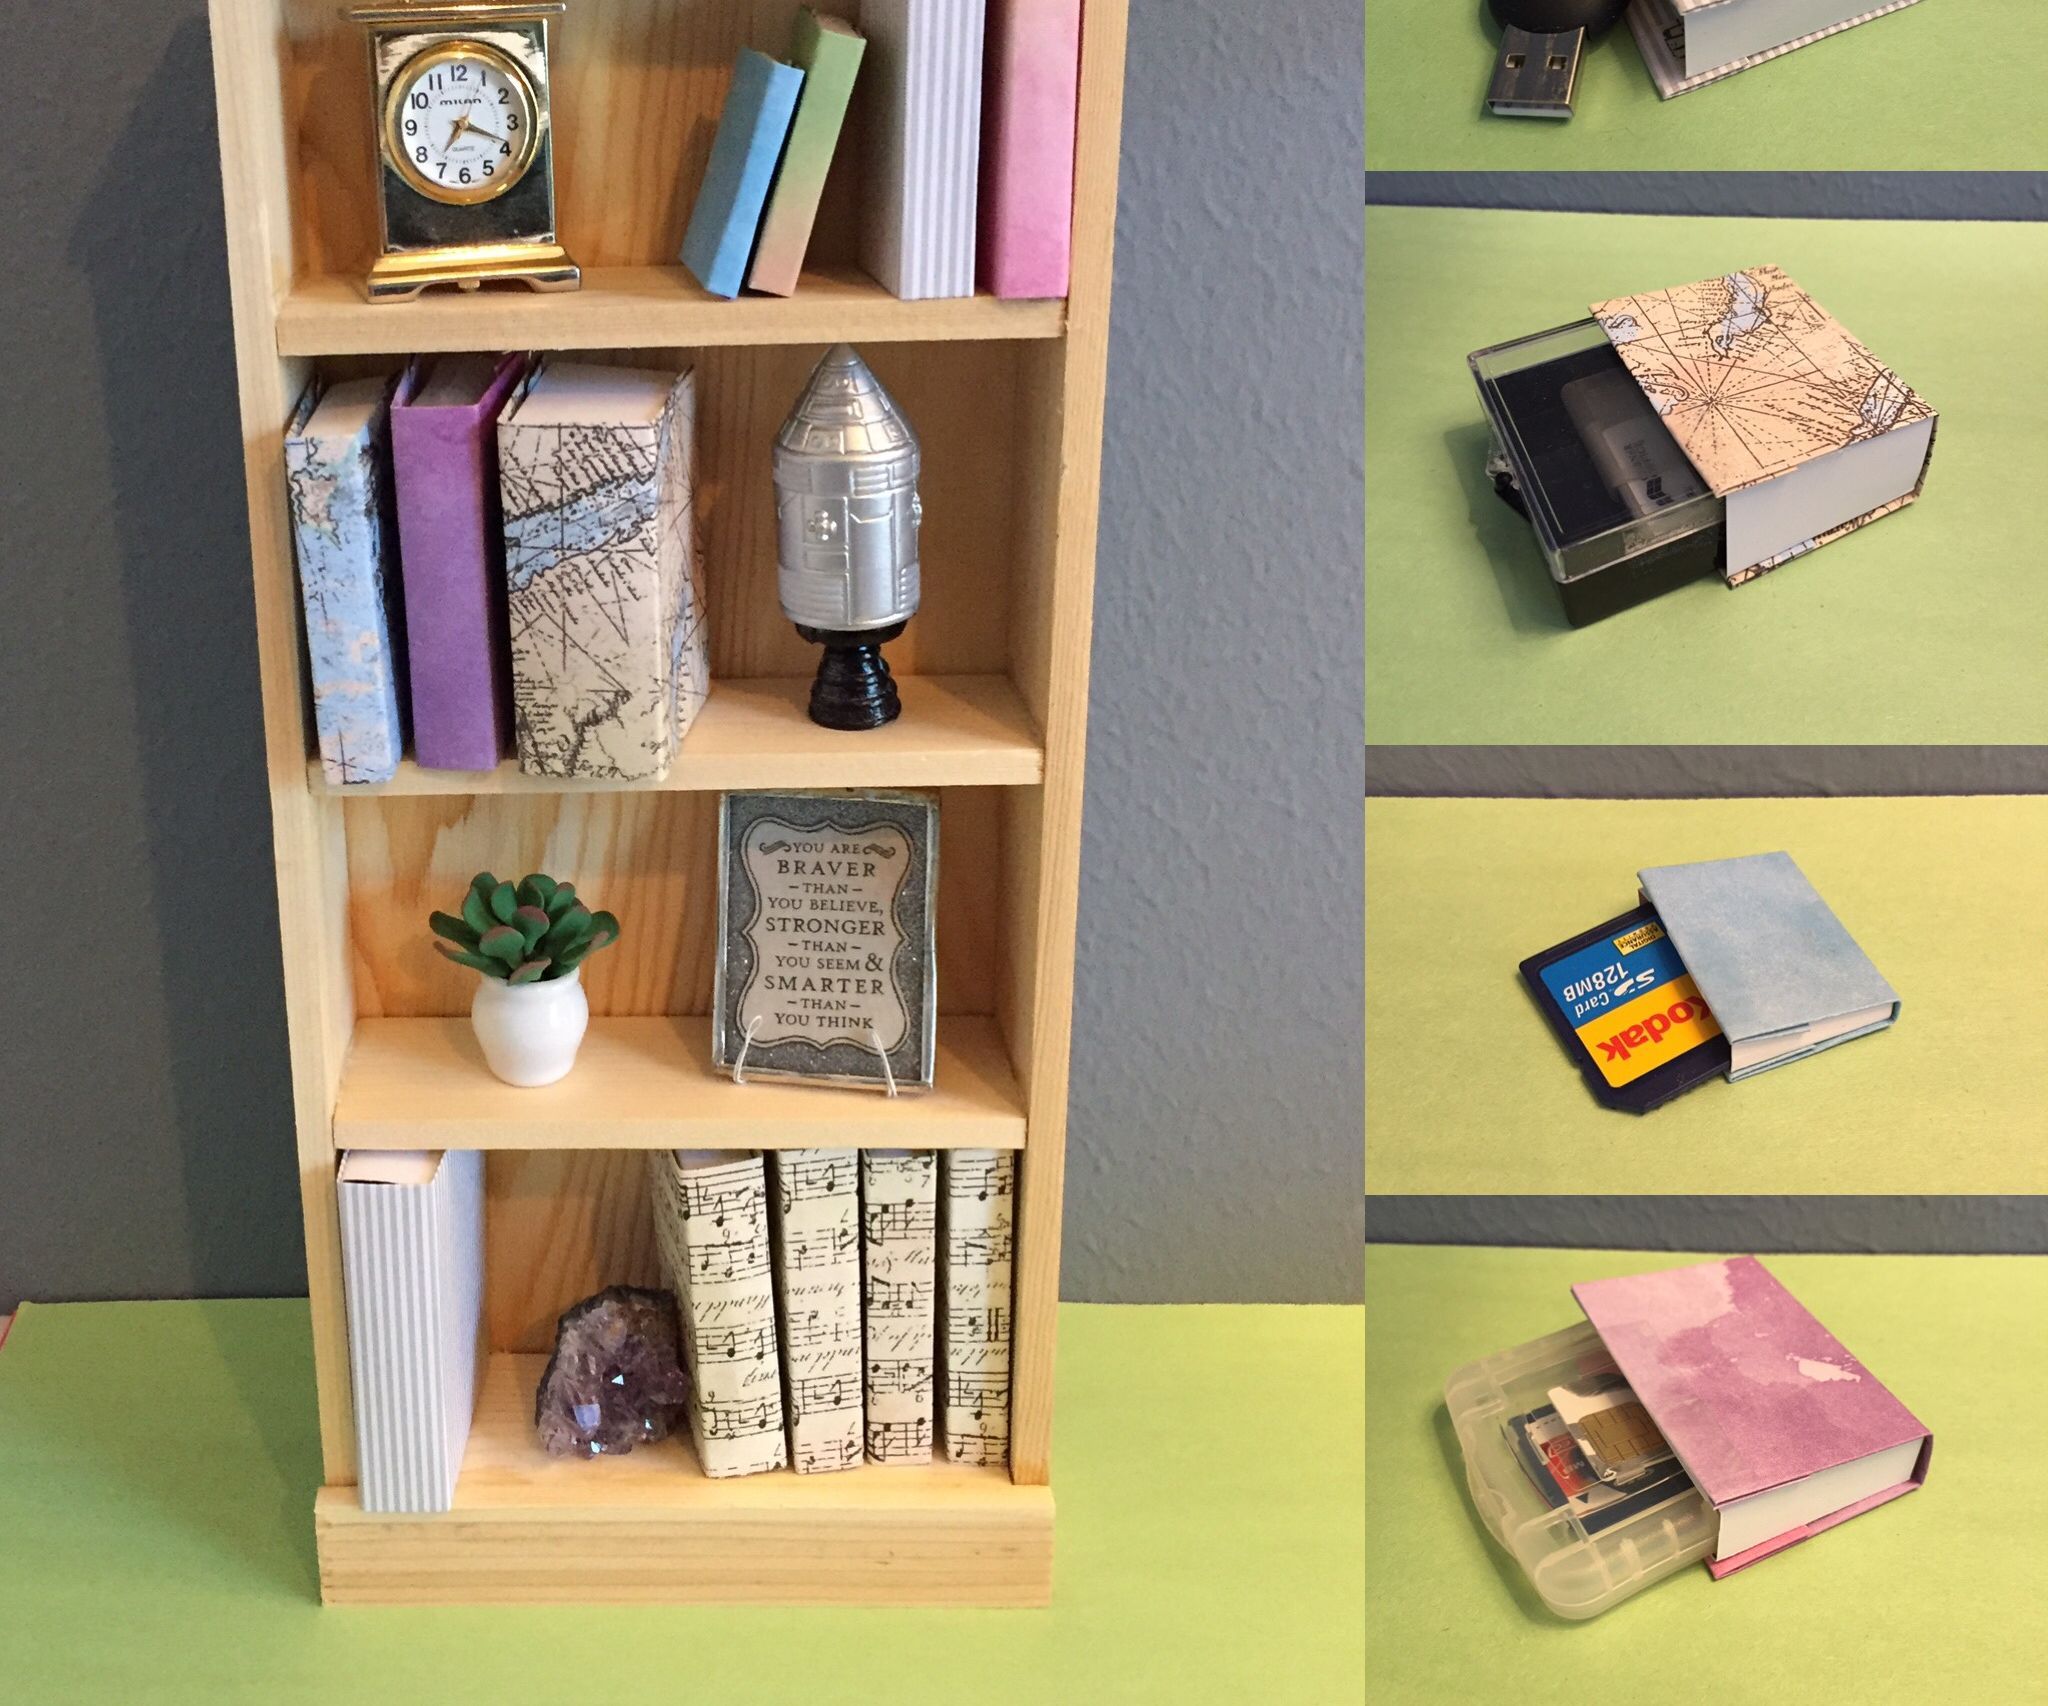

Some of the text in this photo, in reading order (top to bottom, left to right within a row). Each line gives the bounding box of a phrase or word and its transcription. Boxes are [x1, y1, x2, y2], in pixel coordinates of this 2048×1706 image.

[428, 73, 442, 91] 11
[451, 64, 468, 82] 12
[481, 69, 487, 87] 1
[411, 92, 429, 110] 10
[497, 87, 510, 105] 2
[405, 119, 418, 136] 9
[506, 113, 519, 131] 3
[416, 146, 428, 163] 8
[500, 141, 512, 157] 4
[436, 162, 447, 179] 7
[459, 167, 472, 184] 6
[482, 160, 495, 177] 5
[792, 842, 860, 854] YOU ARE
[777, 859, 876, 877] BRAVER
[768, 896, 884, 916] YOU BELIEVE,
[765, 917, 886, 936] STRONGER
[1631, 934, 1656, 949] DIGITAL
[775, 952, 884, 972] YOU SEEM &
[764, 974, 885, 995] SMARTER
[1563, 962, 1629, 1002] 128MB
[1574, 991, 1610, 1018] Card
[774, 1012, 874, 1029] YOU THINK
